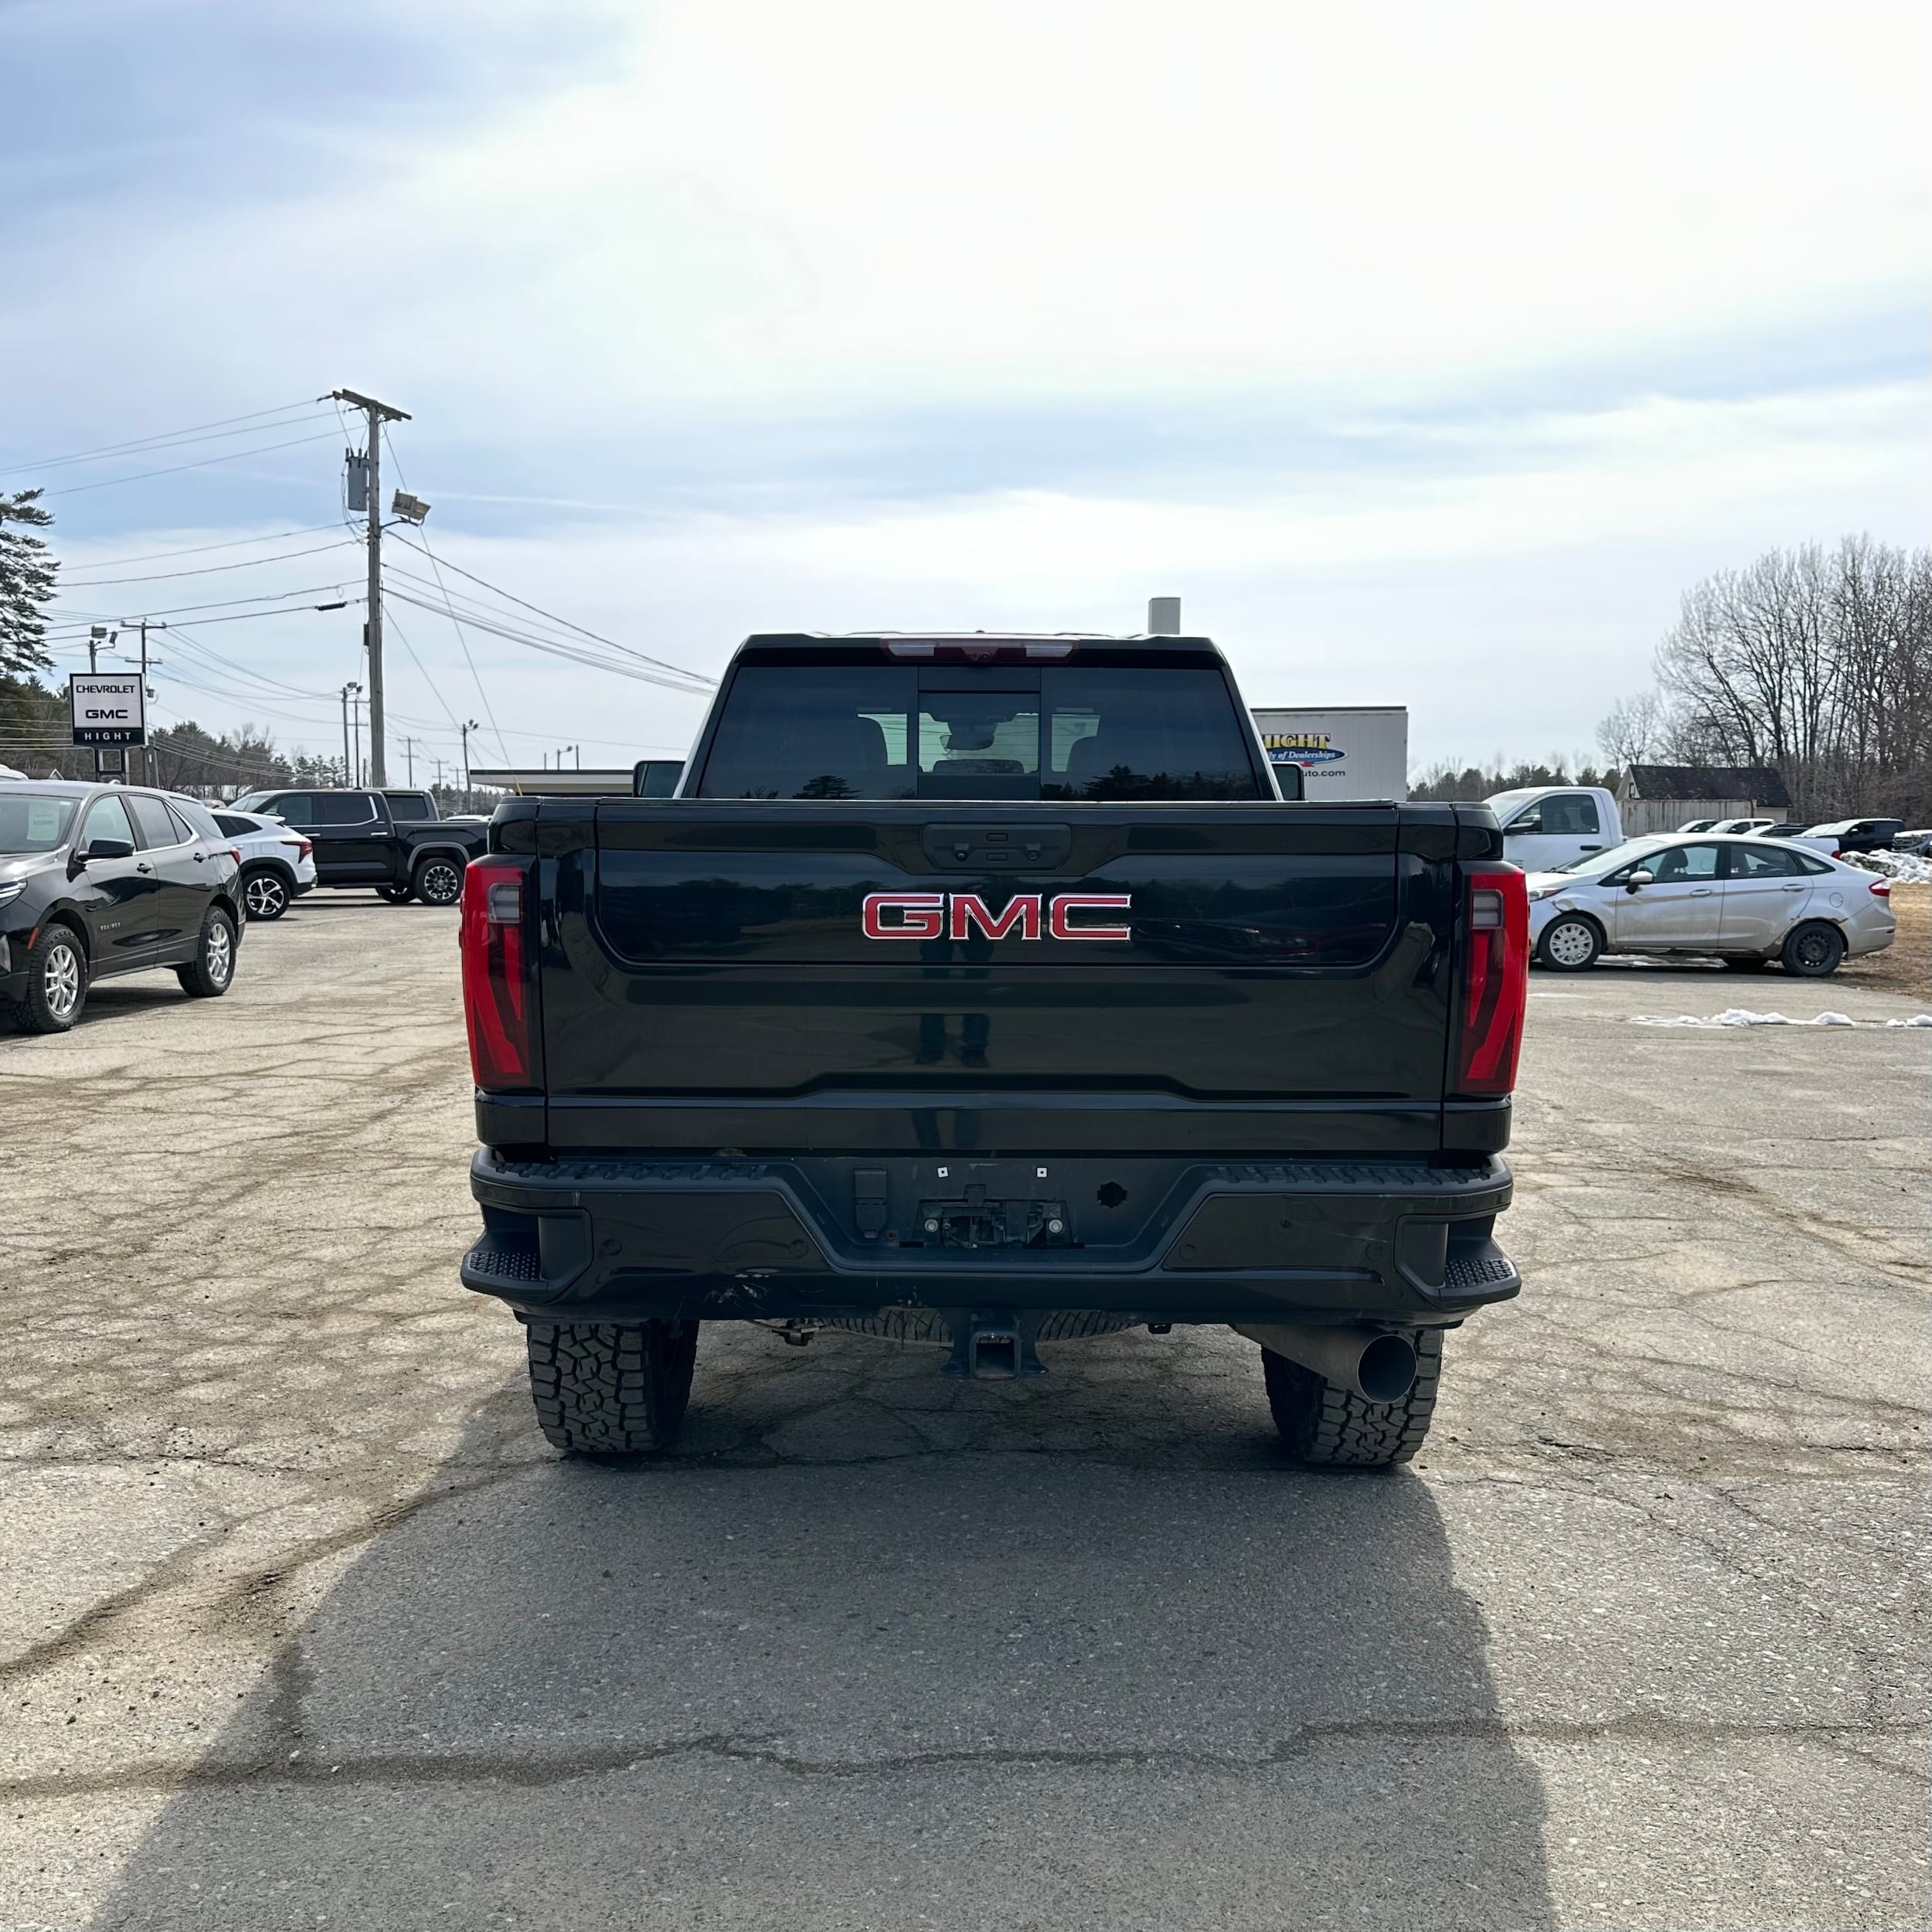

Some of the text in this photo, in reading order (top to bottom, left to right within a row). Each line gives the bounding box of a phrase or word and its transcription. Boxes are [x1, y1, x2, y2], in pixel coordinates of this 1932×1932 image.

[76, 685, 135, 693] CHEVROLET
[85, 709, 128, 719] GMC
[84, 732, 131, 740] HIGHT
[1277, 750, 1288, 760] of
[1289, 750, 1336, 760] Dealerships
[862, 892, 1132, 940] GMC
